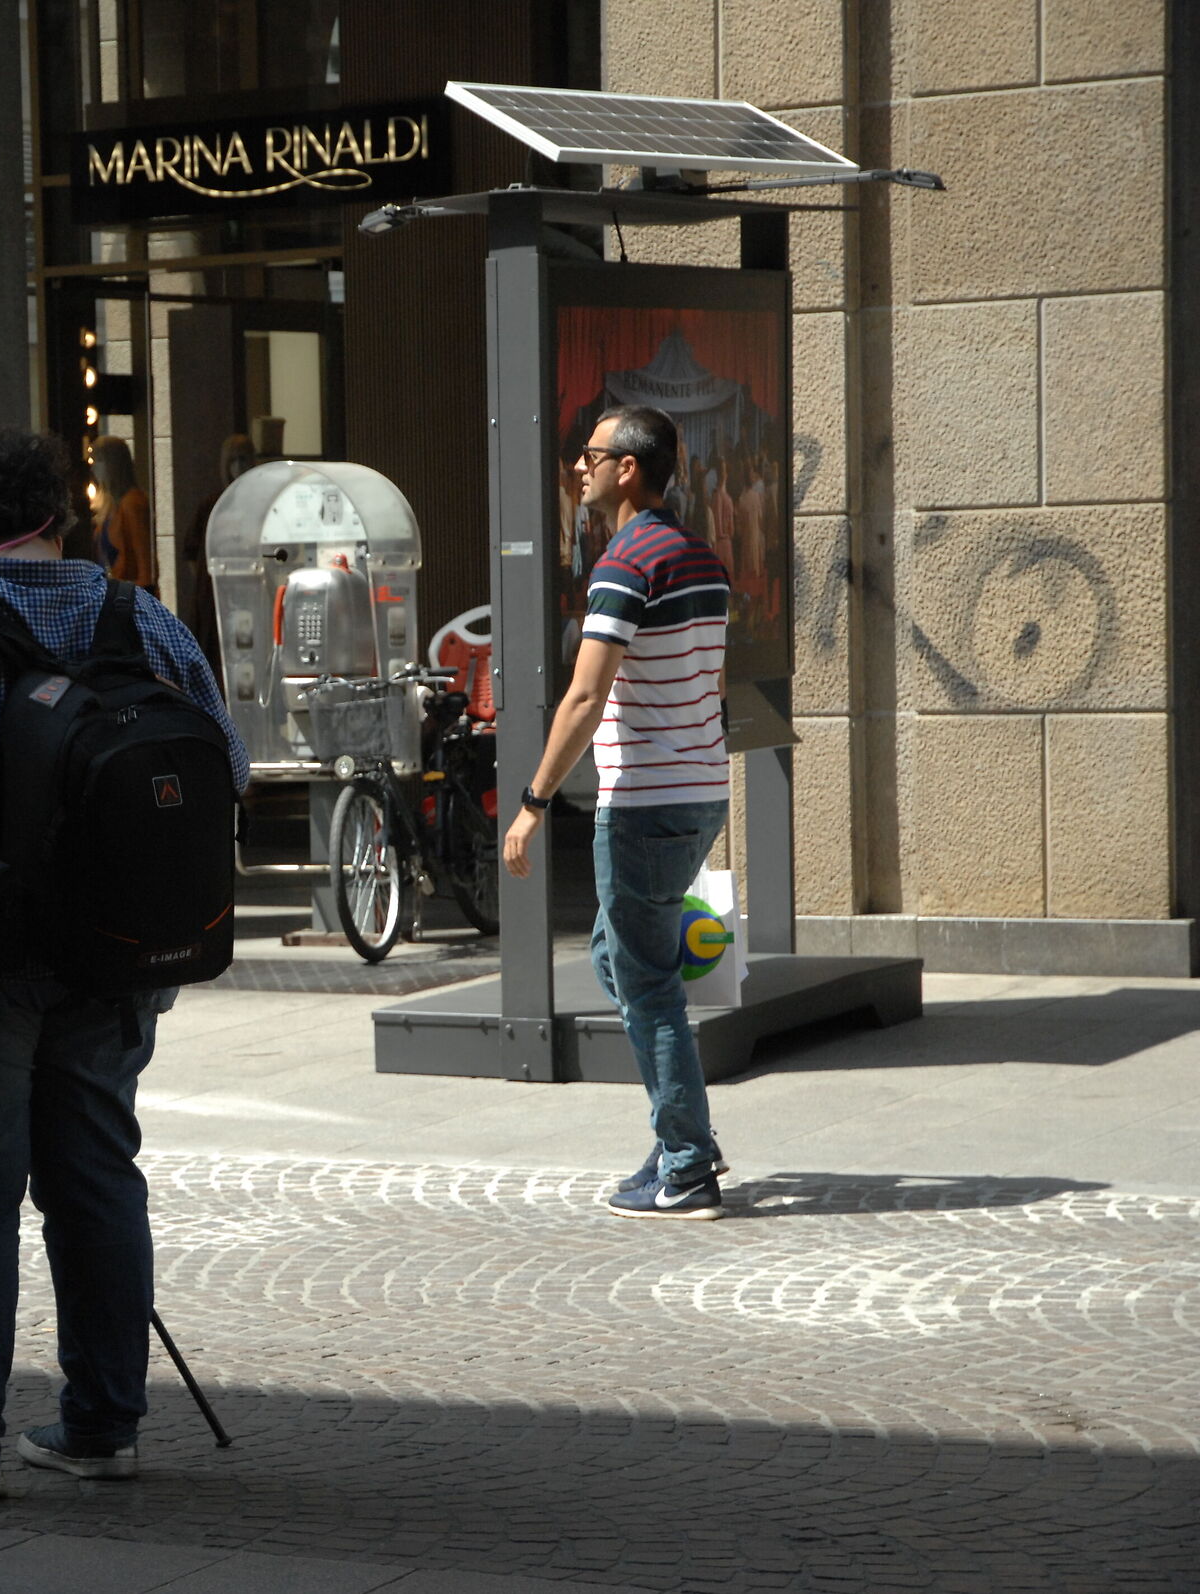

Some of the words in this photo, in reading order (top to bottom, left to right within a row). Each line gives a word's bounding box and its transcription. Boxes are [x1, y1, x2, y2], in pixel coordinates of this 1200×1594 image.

[89, 131, 253, 188] MARINA
[266, 114, 428, 182] RINALDI
[150, 948, 192, 964] E-IMAGE
